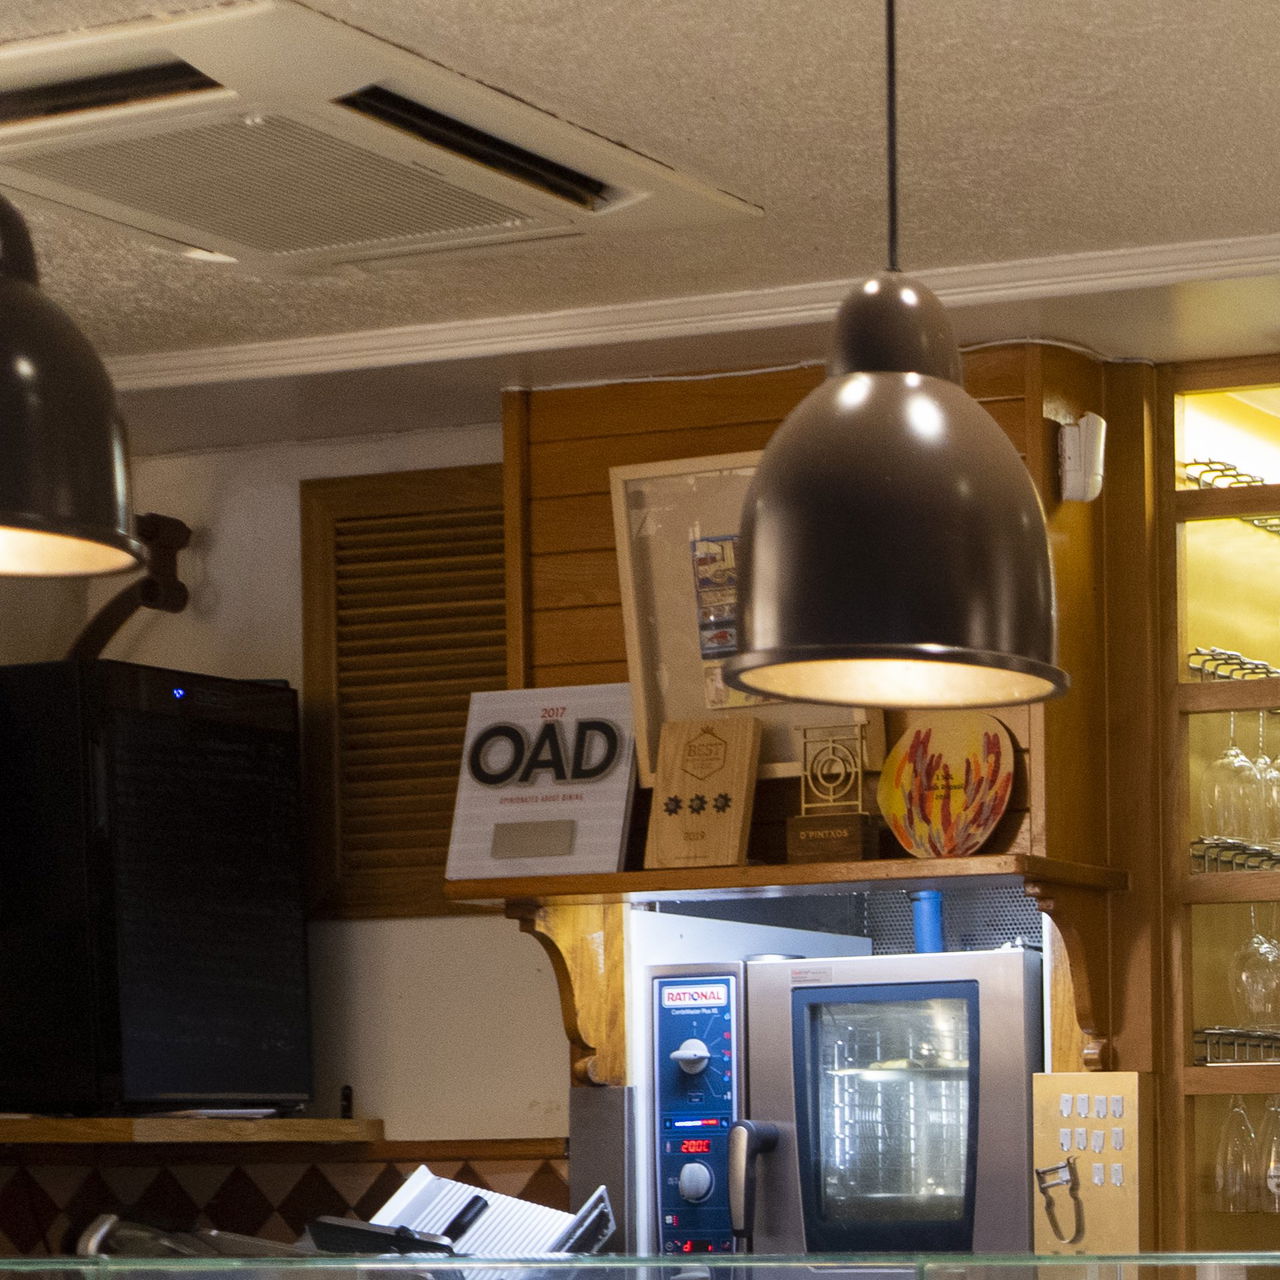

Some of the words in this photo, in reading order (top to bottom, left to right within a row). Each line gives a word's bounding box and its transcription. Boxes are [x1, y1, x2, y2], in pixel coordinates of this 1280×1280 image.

[540, 706, 567, 719] 2017
[470, 721, 620, 786] OAD
[688, 742, 722, 757] BEST
[667, 991, 722, 1002] RATIONAL
